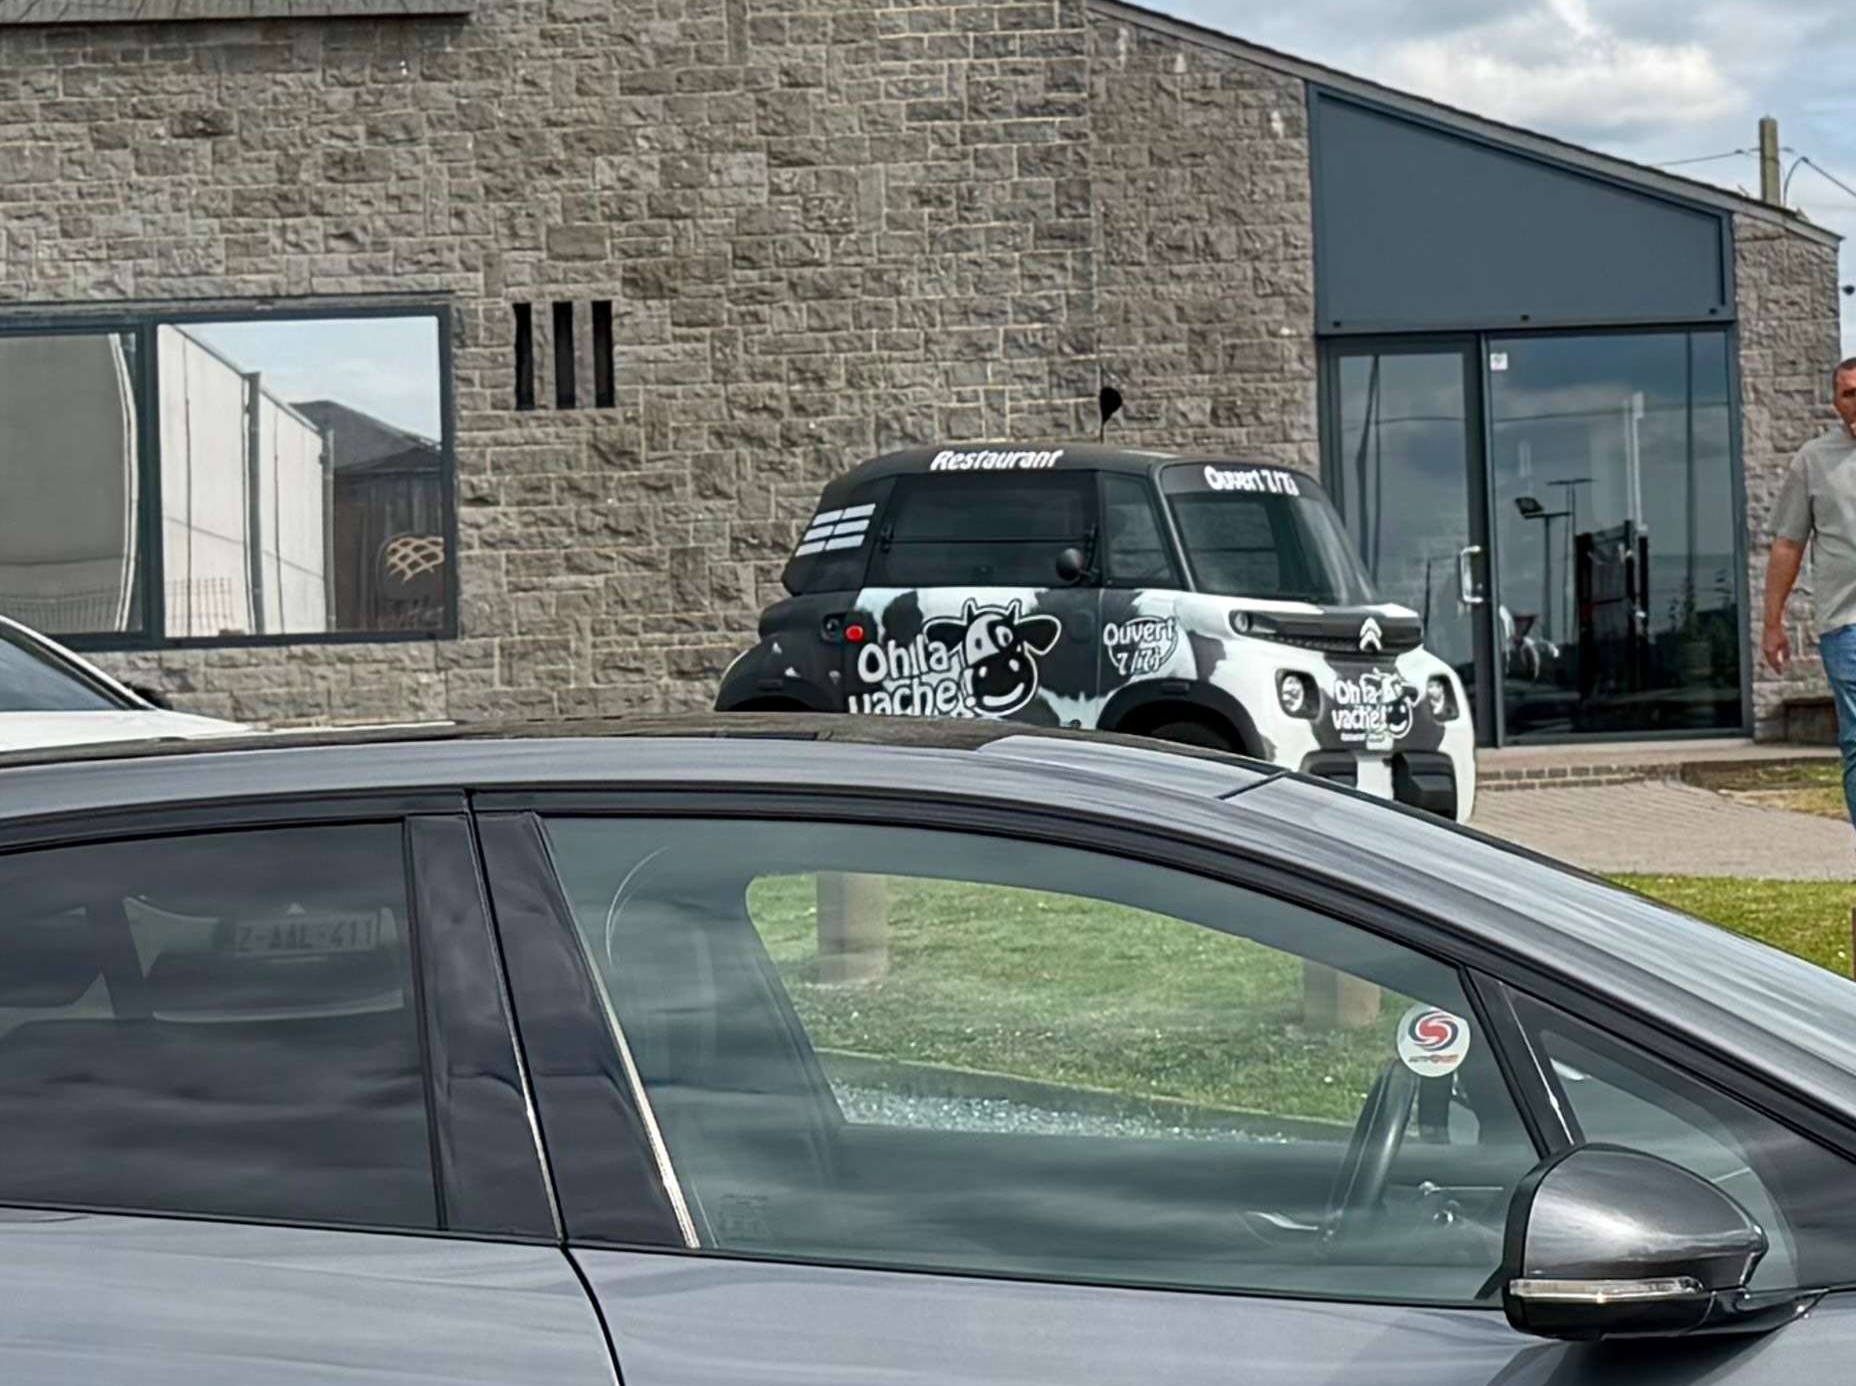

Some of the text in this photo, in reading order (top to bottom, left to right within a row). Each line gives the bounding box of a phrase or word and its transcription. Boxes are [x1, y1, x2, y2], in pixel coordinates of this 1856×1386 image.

[930, 449, 1064, 471] Restaurant
[1204, 465, 1265, 491] Ouvert
[1103, 618, 1173, 645] Ouvert
[858, 639, 910, 683] Oh
